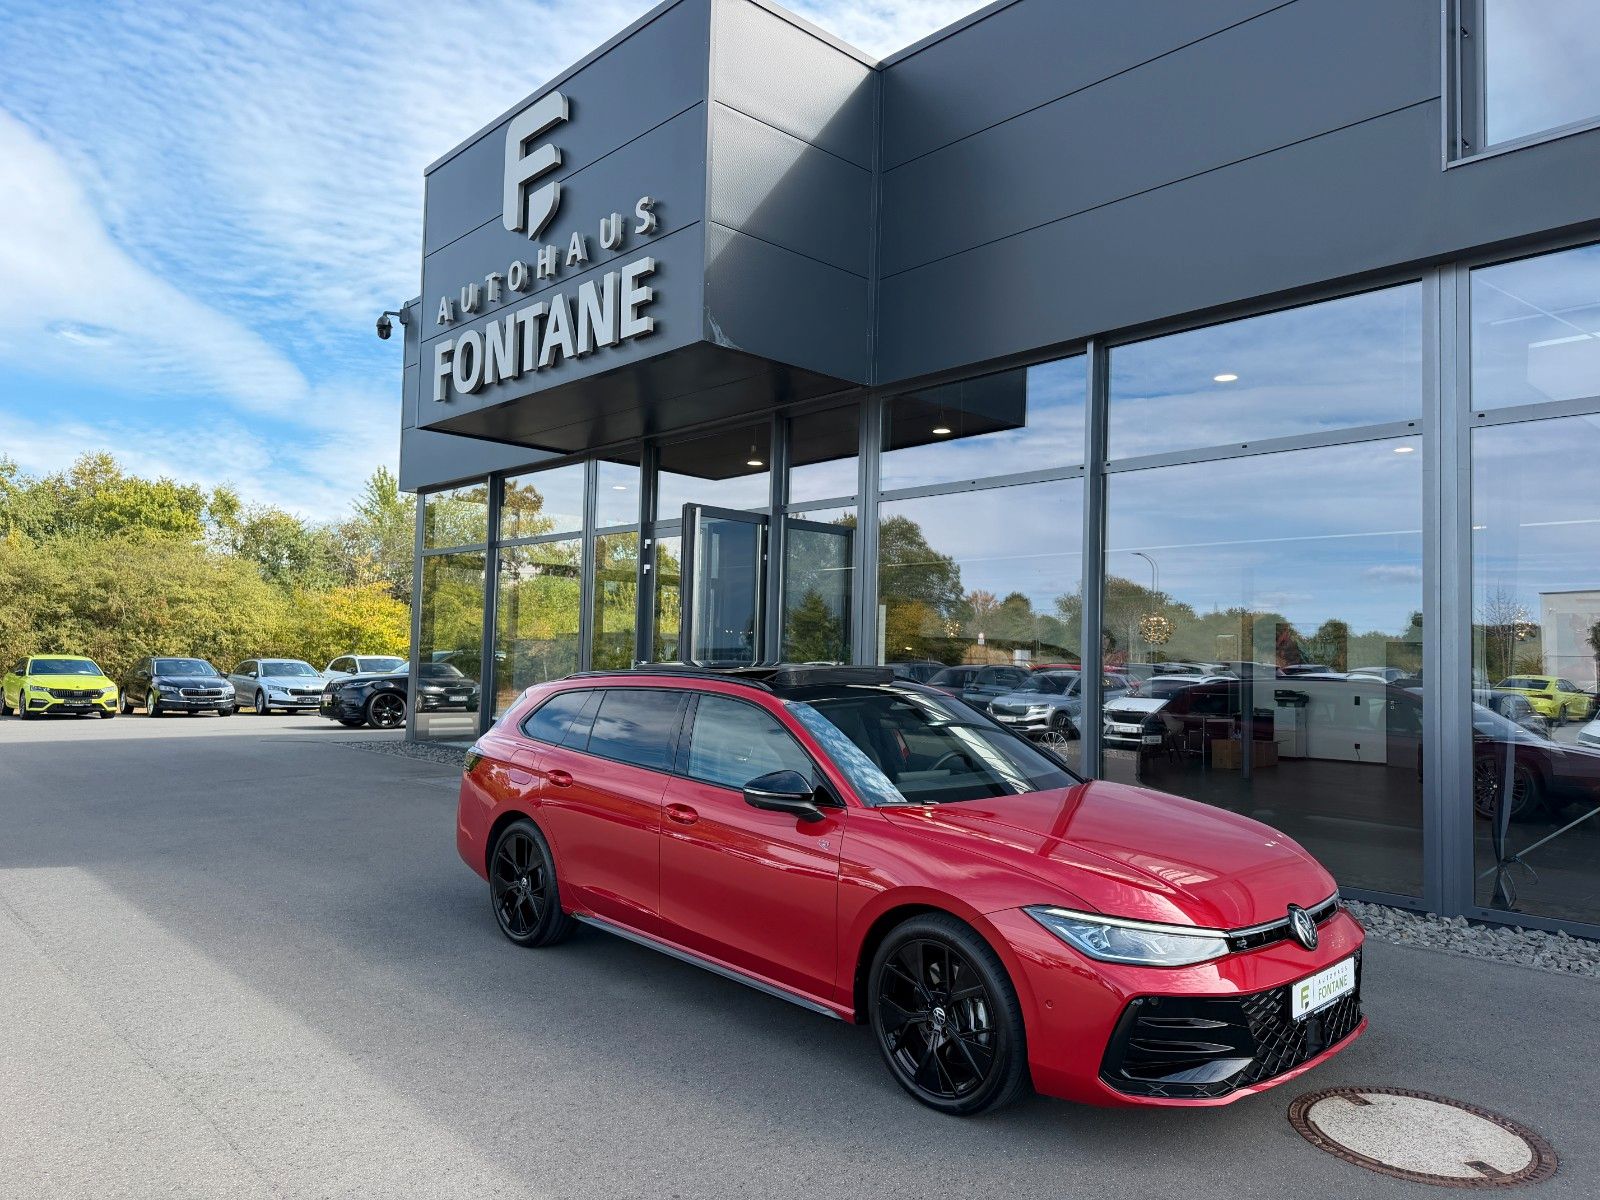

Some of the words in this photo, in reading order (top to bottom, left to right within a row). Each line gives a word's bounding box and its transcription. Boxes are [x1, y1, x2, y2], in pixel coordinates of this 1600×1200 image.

[437, 196, 657, 325] AUTOHAUS
[433, 257, 655, 402] FONTANE
[1318, 975, 1348, 1000] FONTANE
